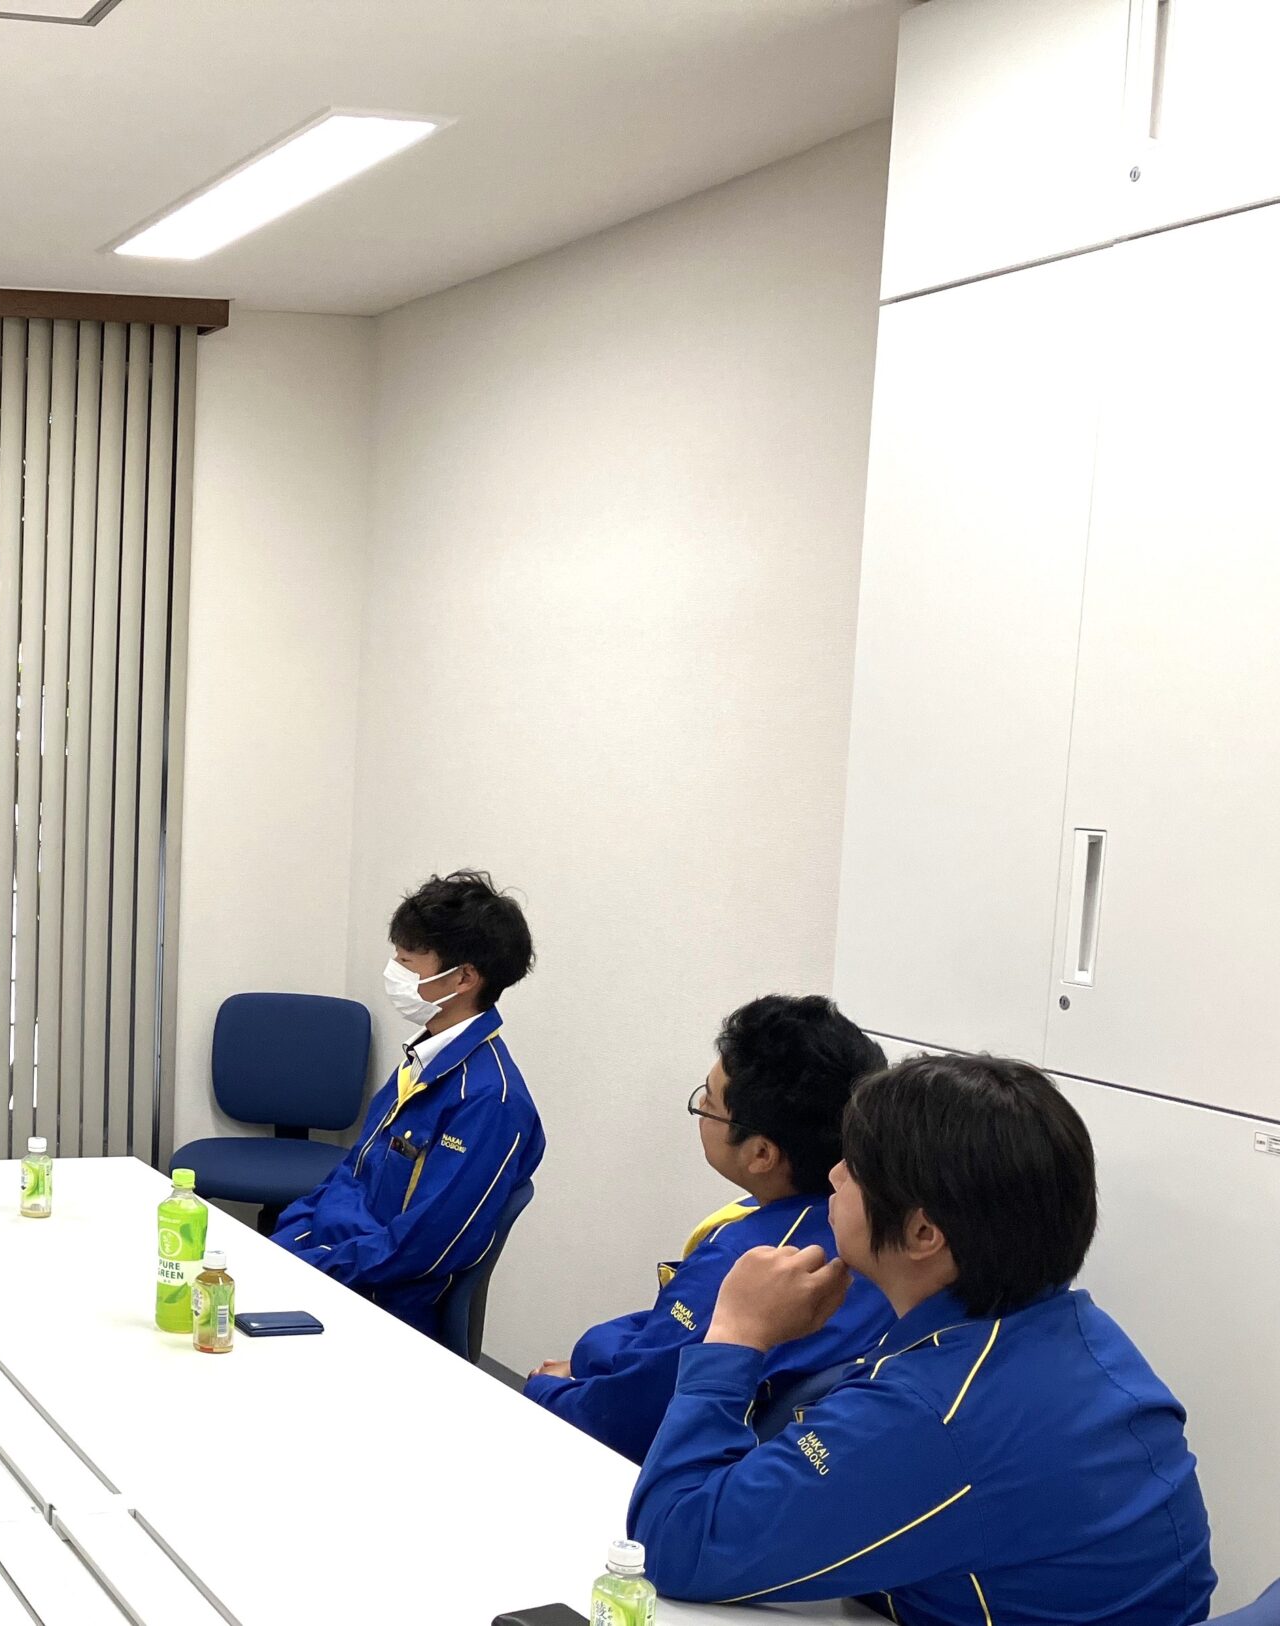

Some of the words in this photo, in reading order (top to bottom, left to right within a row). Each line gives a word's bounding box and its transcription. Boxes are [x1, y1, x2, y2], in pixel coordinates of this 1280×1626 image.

[442, 1133, 463, 1145] NAKAI
[159, 1259, 181, 1271] PURE
[670, 1307, 697, 1331] DOBOKU
[674, 1300, 694, 1318] NAKAI
[805, 1430, 830, 1460] NAKAI
[797, 1436, 830, 1476] DOBOKU
